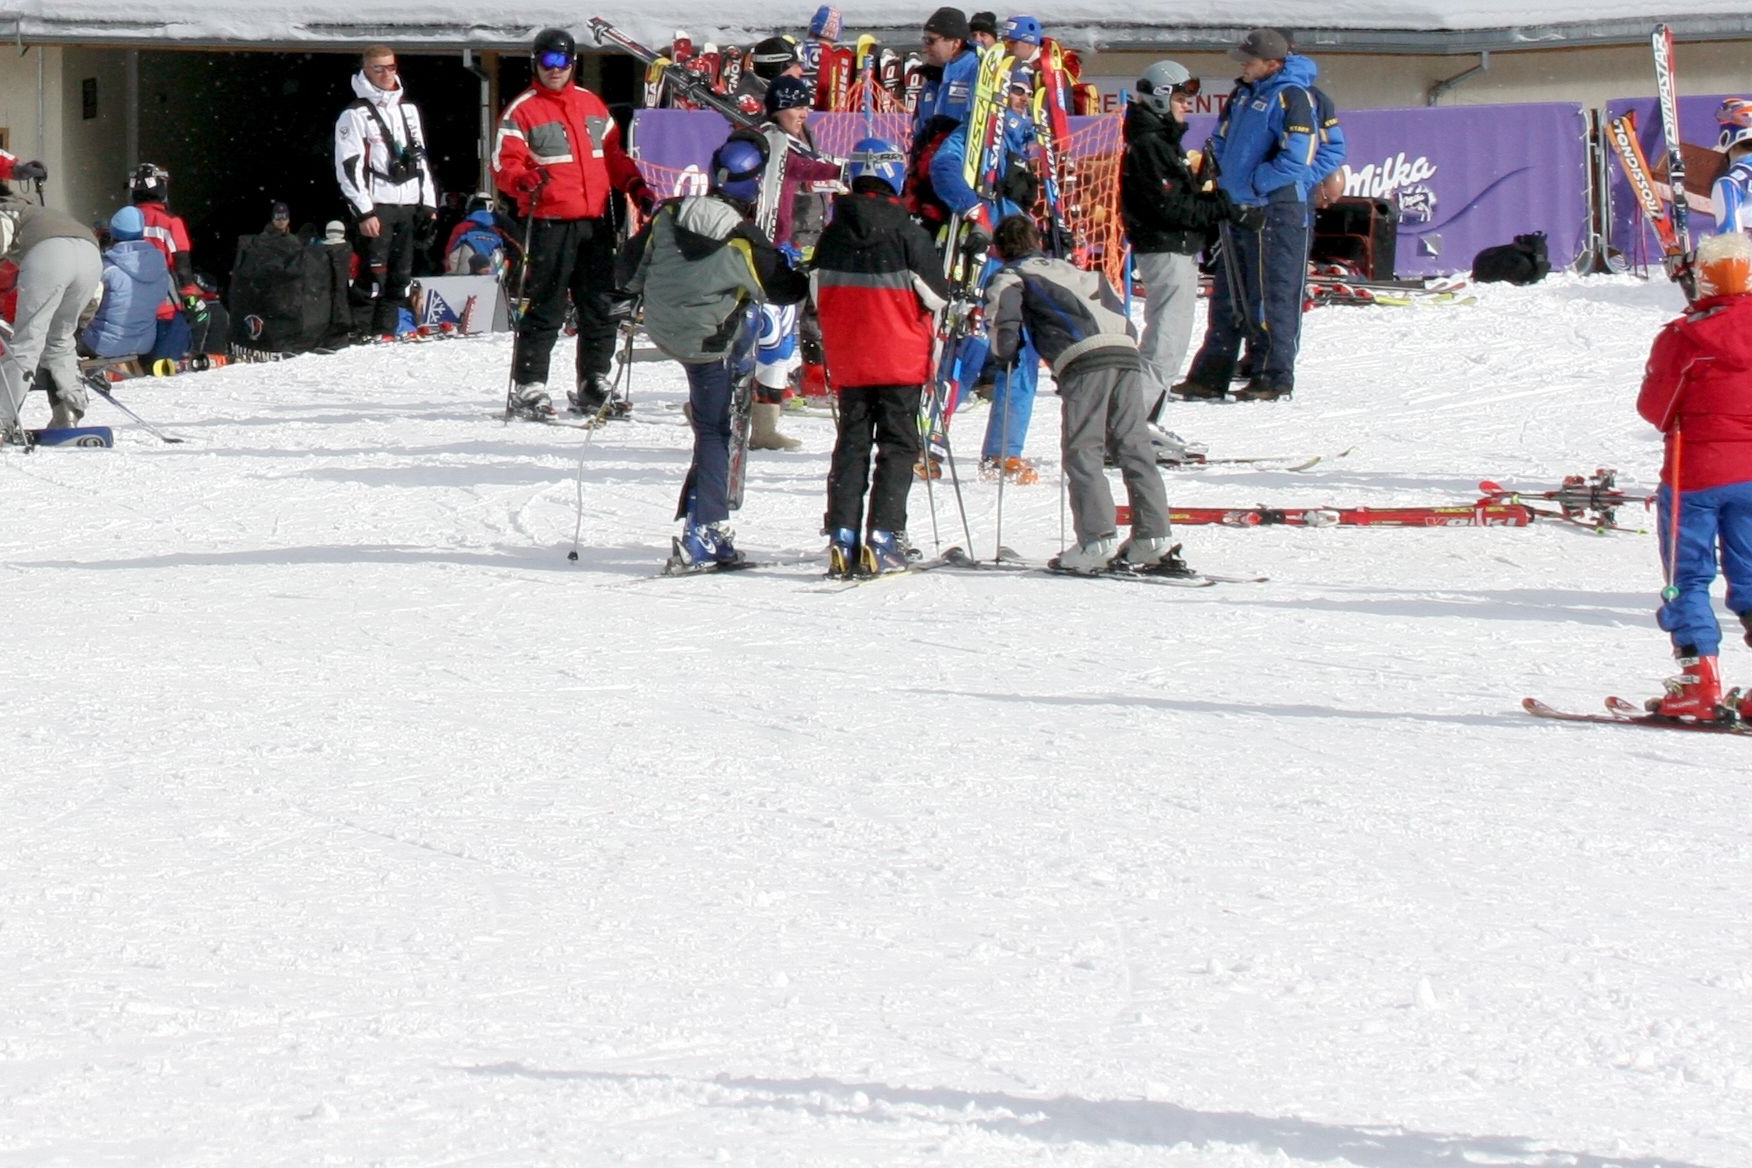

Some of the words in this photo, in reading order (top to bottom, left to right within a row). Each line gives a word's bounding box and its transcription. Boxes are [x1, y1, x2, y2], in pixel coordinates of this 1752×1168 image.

[1653, 32, 1677, 145] DYNASTAR
[1342, 152, 1437, 198] Milka
[1612, 122, 1661, 214] ROSSIGNOL
